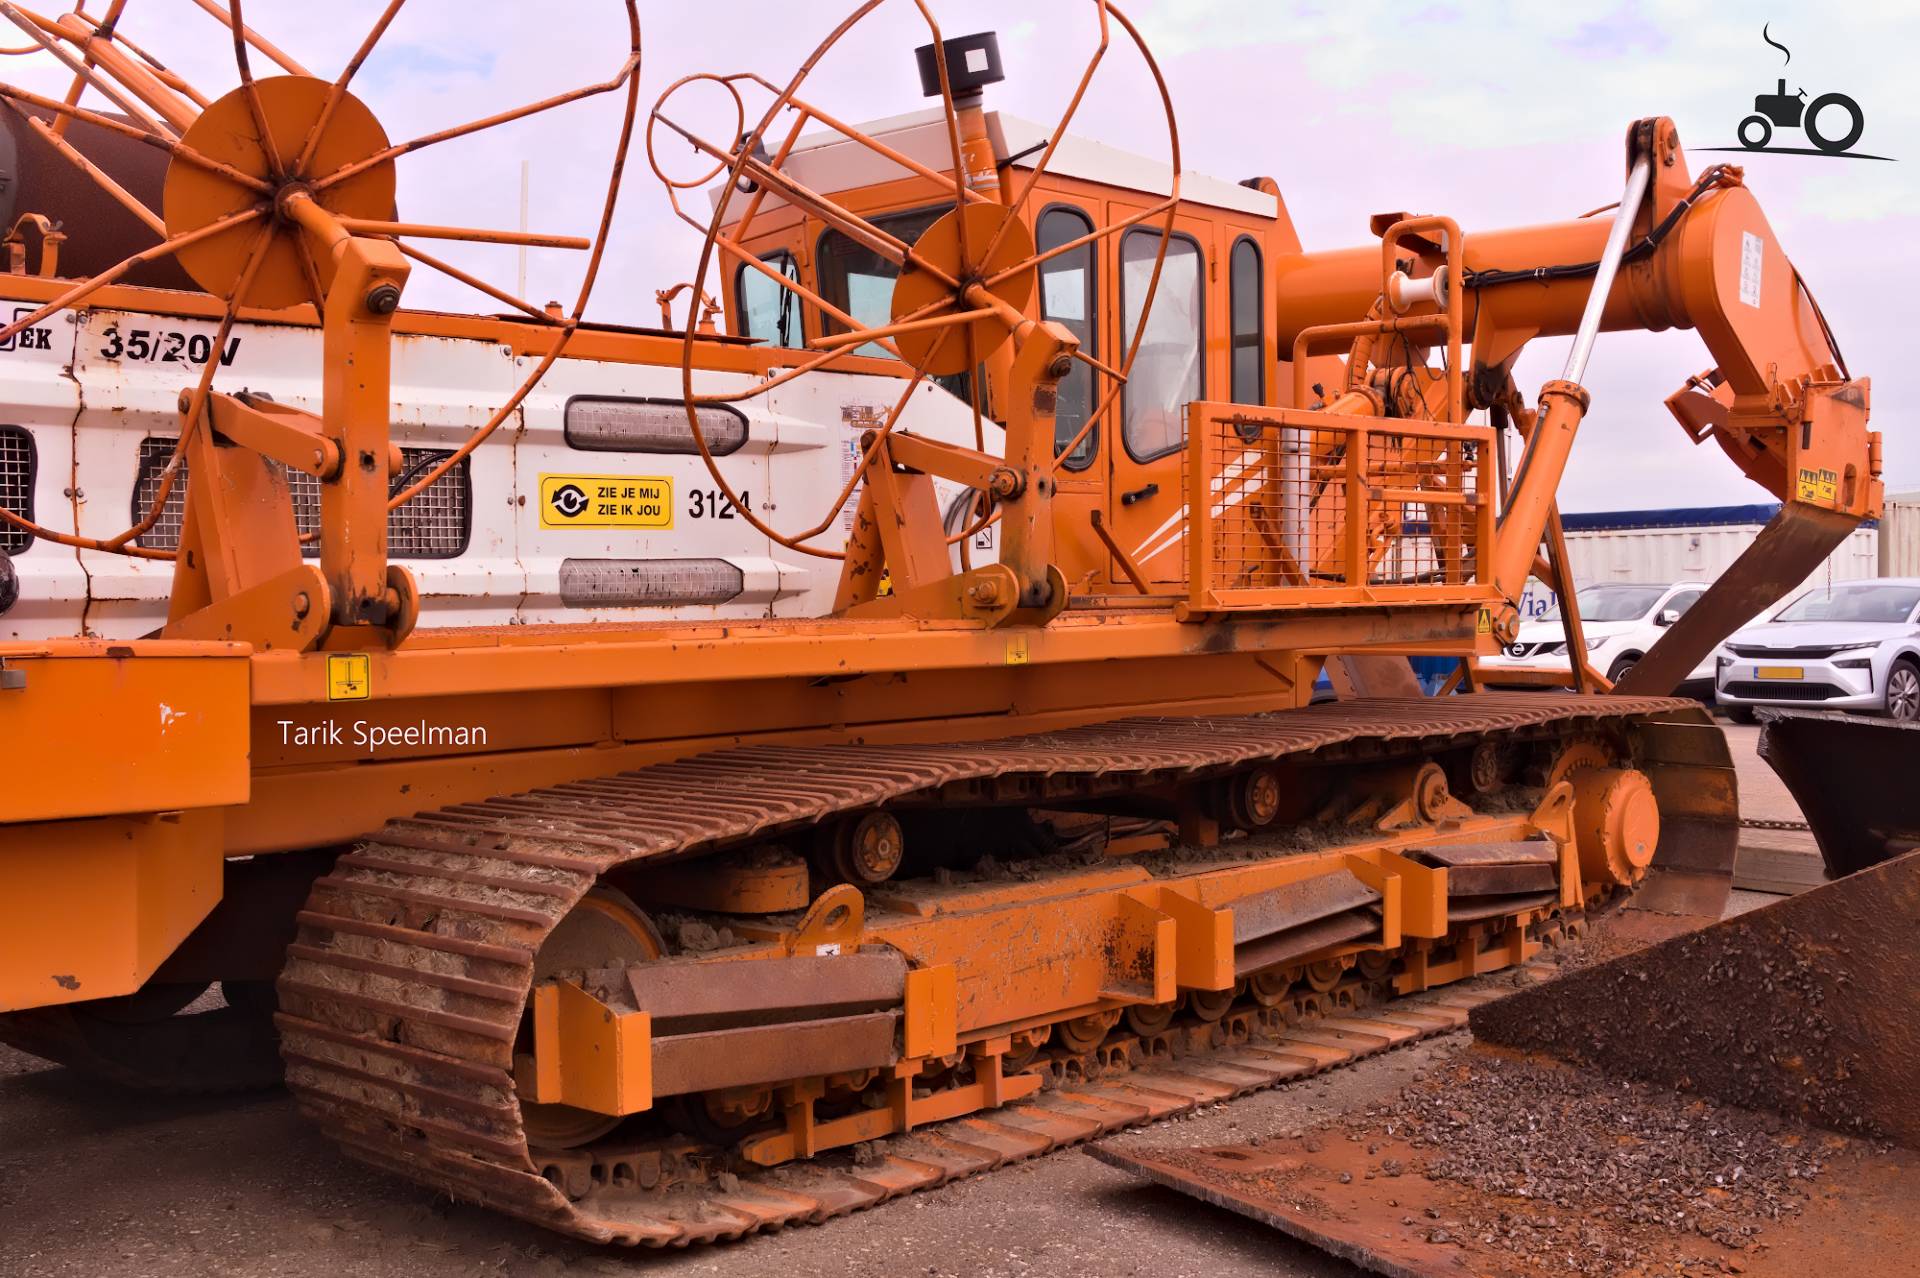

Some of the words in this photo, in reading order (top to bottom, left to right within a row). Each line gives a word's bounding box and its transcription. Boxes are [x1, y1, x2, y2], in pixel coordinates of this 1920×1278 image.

[598, 487, 617, 498] ZIE
[621, 487, 635, 498] JE
[640, 488, 660, 499] MIJ
[598, 504, 617, 515] ZIE
[621, 504, 633, 515] IK
[637, 505, 660, 516] JOU
[688, 489, 752, 519] 3124
